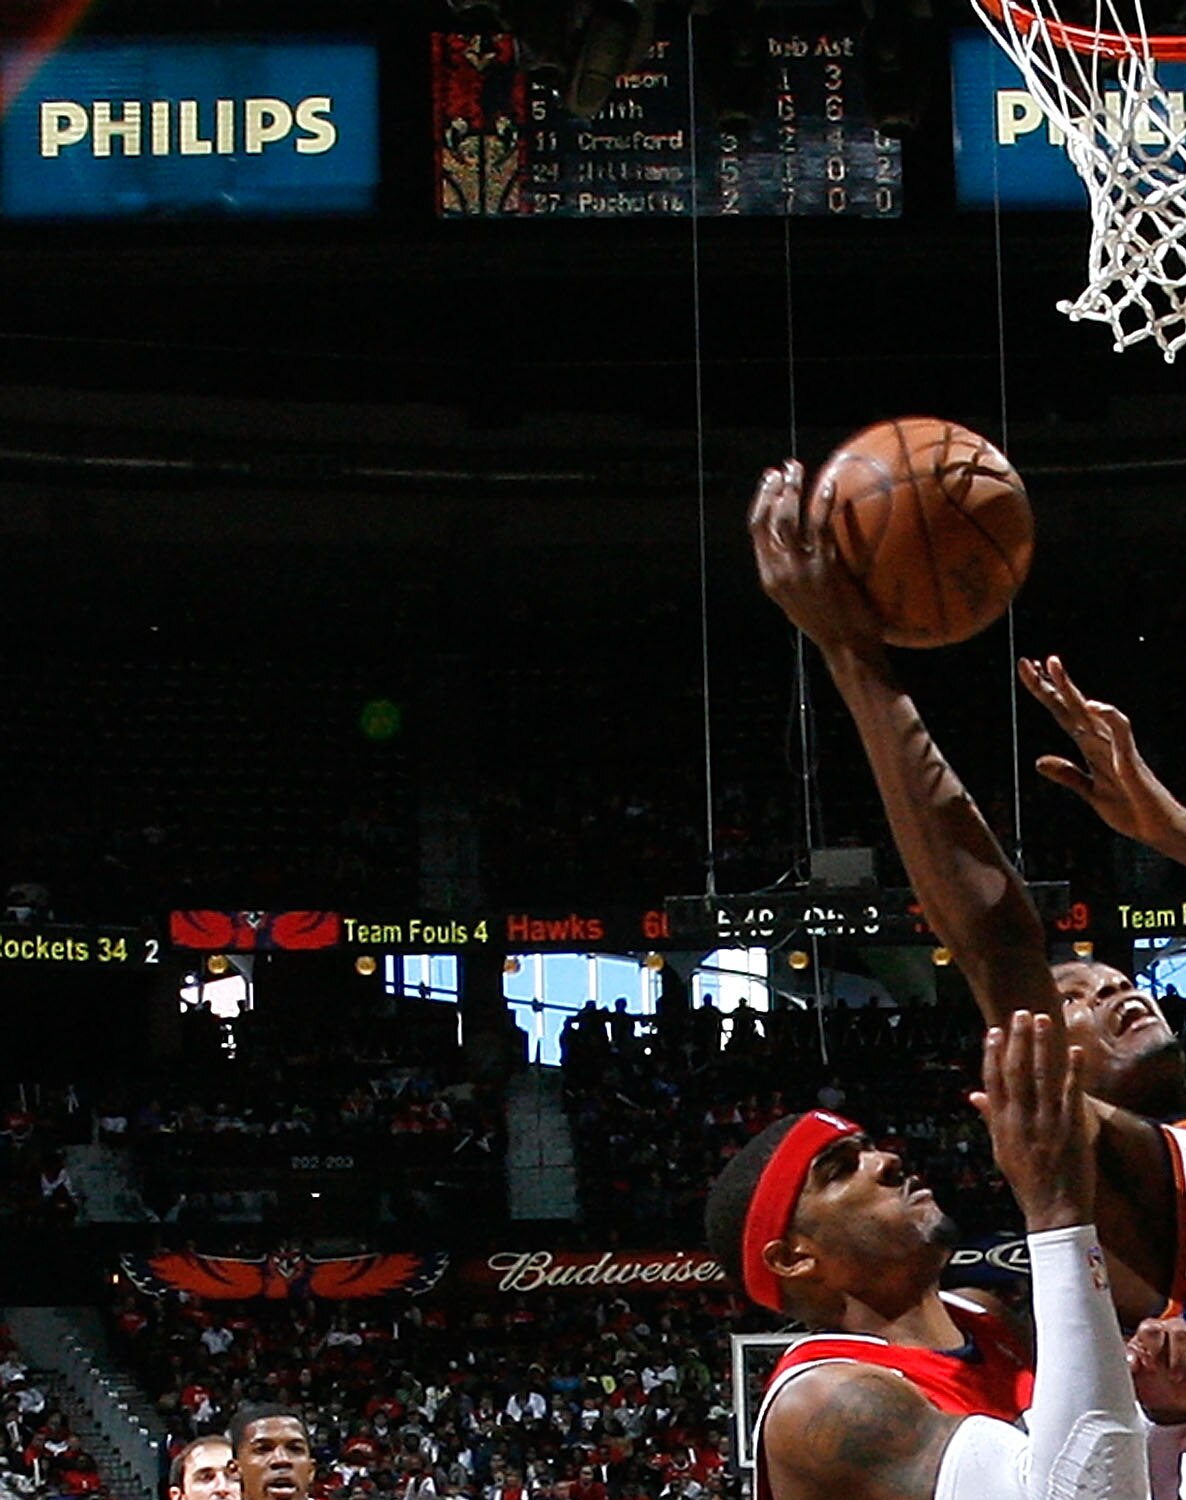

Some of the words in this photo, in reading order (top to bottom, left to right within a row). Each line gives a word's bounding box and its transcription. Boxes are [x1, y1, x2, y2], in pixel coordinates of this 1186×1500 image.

[814, 34, 854, 57] Ast
[824, 64, 843, 90] 3
[40, 97, 337, 157] PHILIPS
[720, 156, 740, 183] 5
[827, 155, 845, 182] 0
[875, 156, 896, 183] 2
[828, 186, 847, 213] 0
[875, 187, 892, 213] 0
[507, 914, 604, 942] Hawks
[1118, 905, 1176, 929] Team
[344, 919, 402, 944] Team
[409, 919, 469, 944] Fouls
[473, 920, 489, 944] 4
[0, 933, 91, 962] ockets
[96, 937, 129, 963] 34
[144, 939, 160, 964] 2
